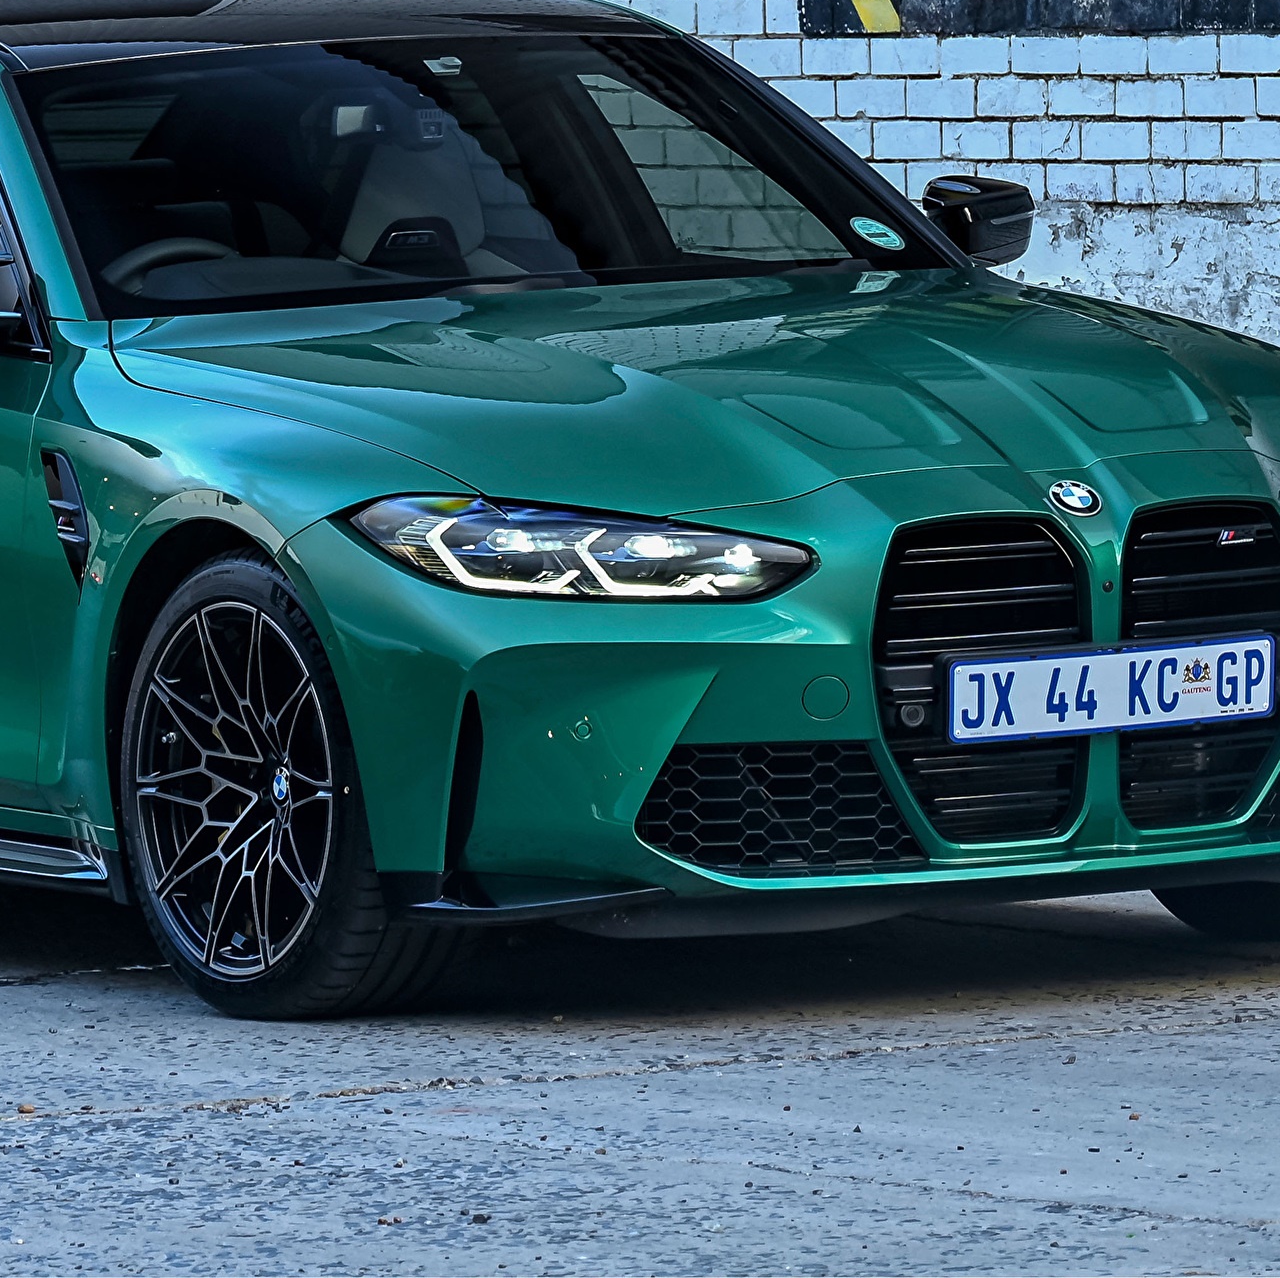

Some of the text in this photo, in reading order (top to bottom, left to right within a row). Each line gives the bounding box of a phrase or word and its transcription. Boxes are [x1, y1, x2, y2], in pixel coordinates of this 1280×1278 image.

[961, 649, 1265, 729] JX 44 KC GP
[1181, 685, 1212, 695] GAUTENG
